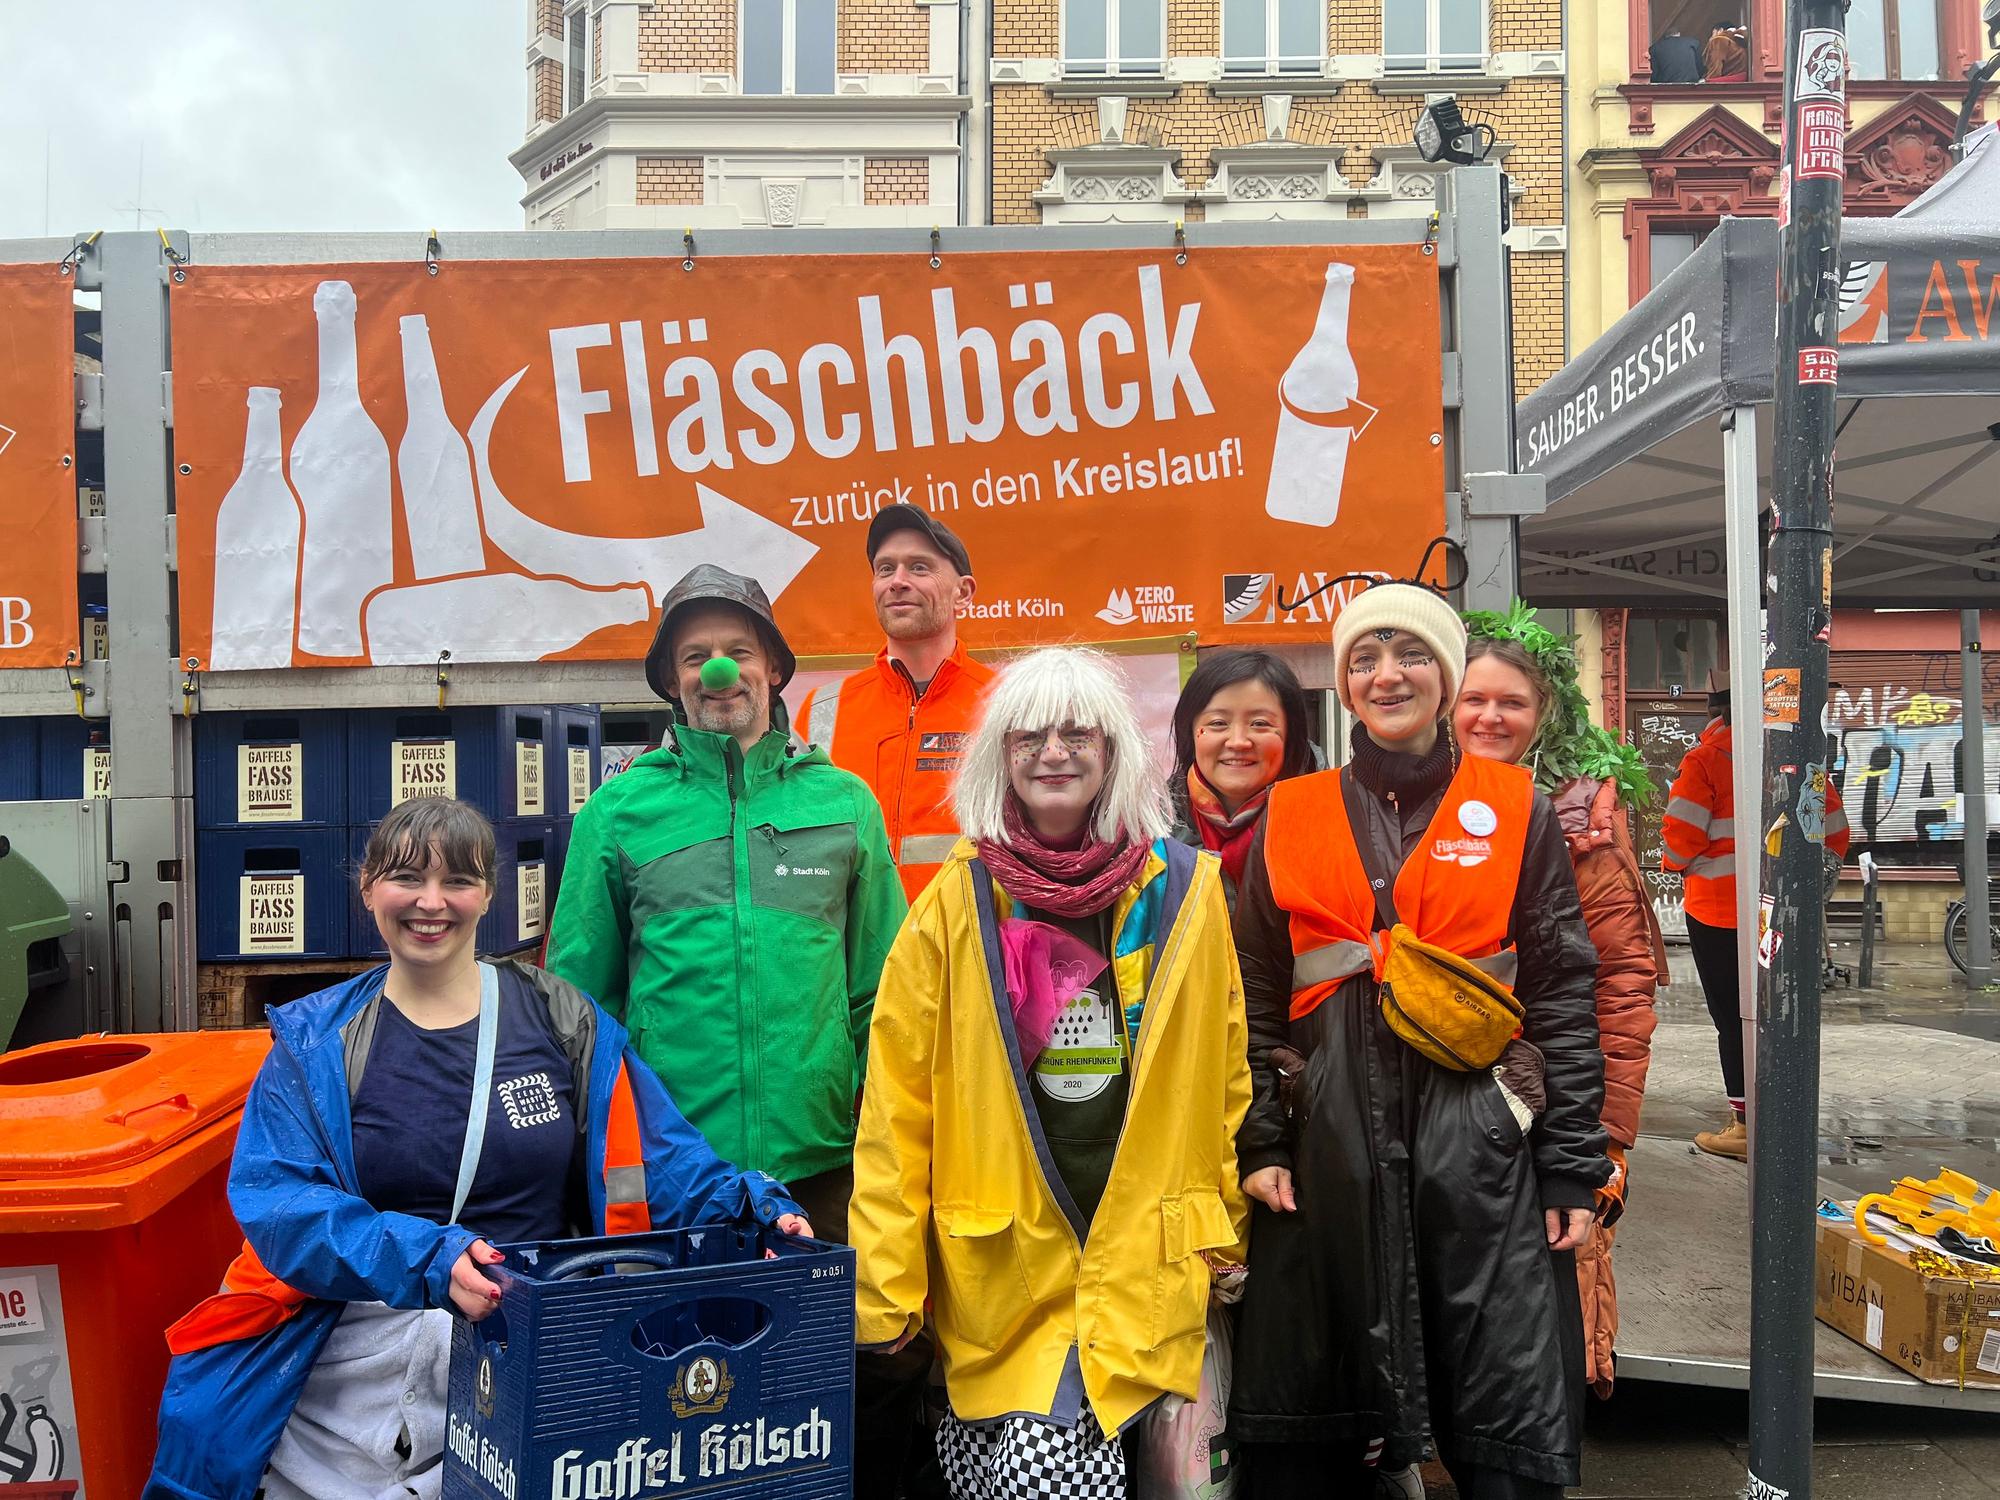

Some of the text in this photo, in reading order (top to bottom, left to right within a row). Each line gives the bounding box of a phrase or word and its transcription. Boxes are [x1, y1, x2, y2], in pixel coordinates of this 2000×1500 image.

[1905, 259, 2000, 343] AW
[549, 265, 1215, 483] Fläschbäck
[1528, 311, 1705, 468] SAUBER. BESSER.
[789, 437, 1244, 526] zurück in den Kreislauf!
[1135, 585, 1175, 605] ZERO
[1283, 571, 1393, 624] AW
[1017, 598, 1064, 617] Köln
[1141, 604, 1195, 624] WASTE
[1672, 686, 1680, 697] 5
[248, 750, 292, 763] GAFFELS
[402, 748, 445, 760] GAFFELS
[249, 765, 292, 786] FASS
[402, 762, 446, 783] FASS
[524, 764, 537, 783] FASS
[573, 767, 585, 784] FASS
[249, 789, 292, 802] BRAUSE
[402, 786, 446, 799] BRAUSE
[793, 866, 830, 876] Stadt Köln
[250, 883, 294, 896] GAFFELS
[525, 885, 540, 906] FASS
[250, 898, 294, 919] FASS
[250, 921, 294, 935] BRAUSE
[1066, 1056, 1117, 1066] RHEINFUNKEN
[516, 1088, 540, 1099] ZERO
[1063, 1080, 1082, 1089] 2020
[519, 1094, 543, 1106] WASTE
[812, 1268, 821, 1279] 20
[829, 1266, 840, 1277] 0,5
[449, 1413, 516, 1500] Gaffel Kölsch
[551, 1406, 831, 1500] Gaffel Kölsch
